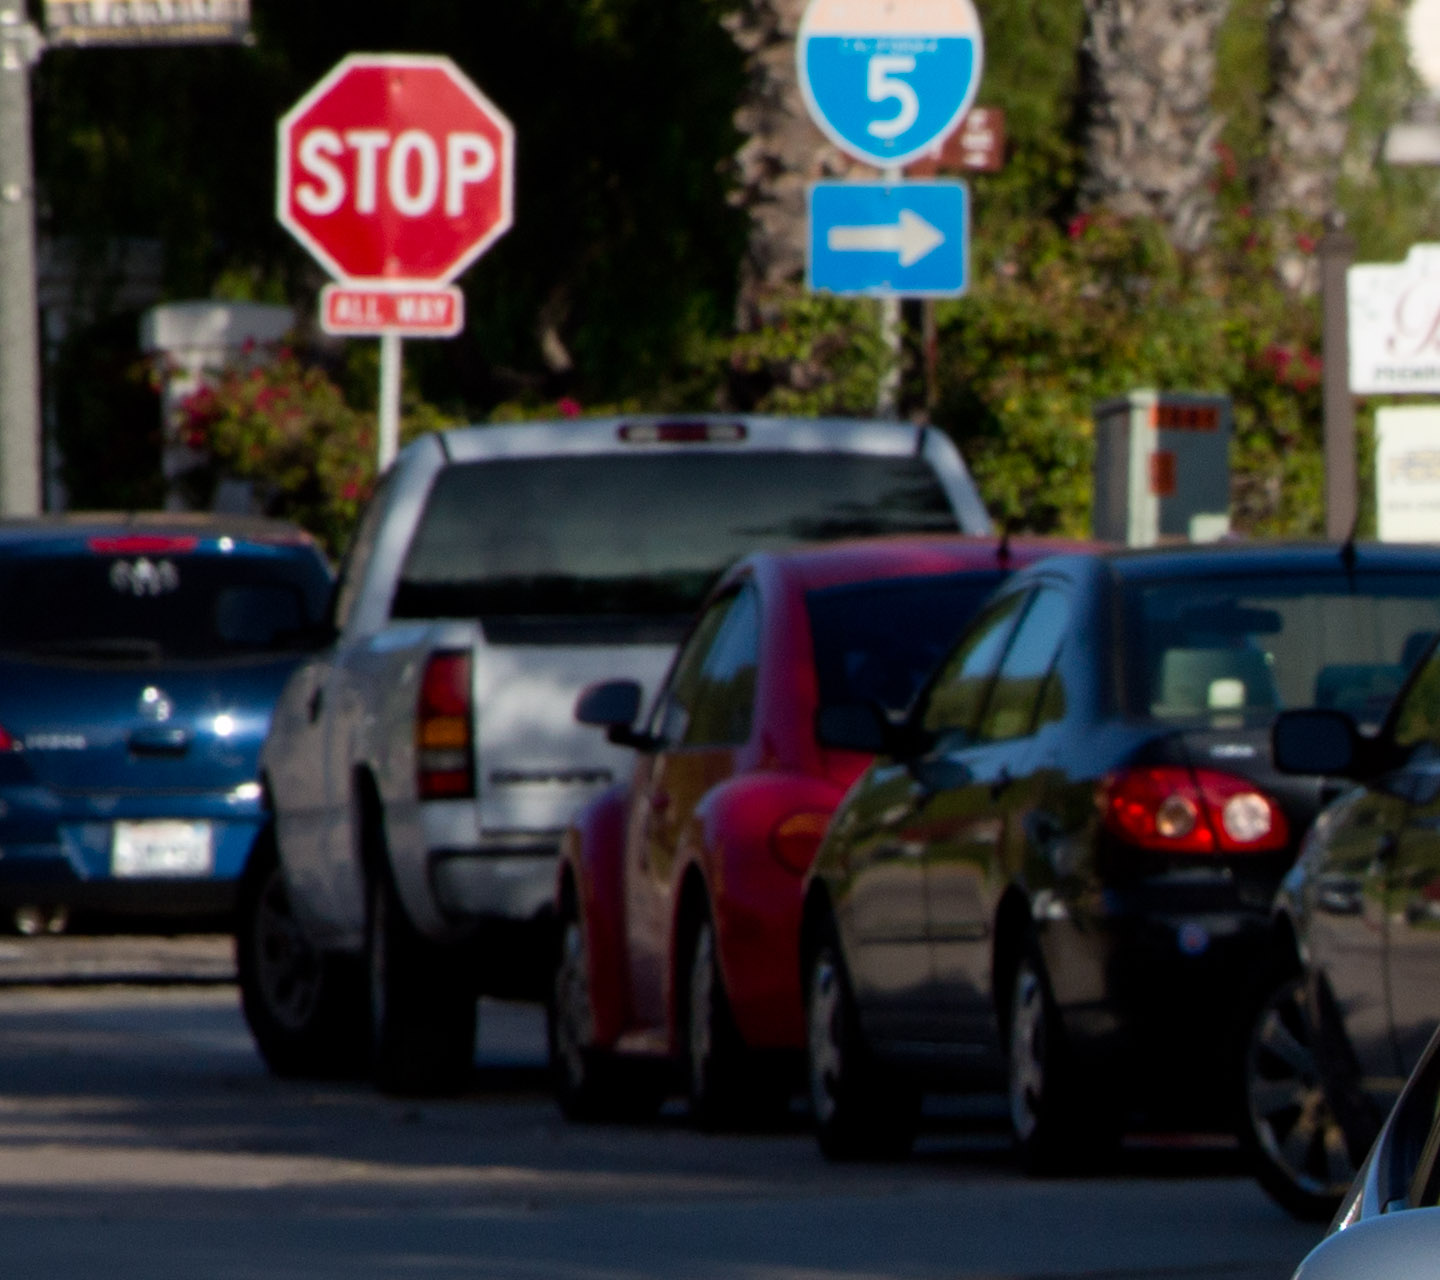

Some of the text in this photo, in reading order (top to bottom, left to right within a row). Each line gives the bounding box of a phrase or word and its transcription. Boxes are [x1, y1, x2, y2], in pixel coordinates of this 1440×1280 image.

[866, 53, 919, 139] 5
[295, 127, 496, 218] STOP
[334, 297, 449, 323] ALL WAY
